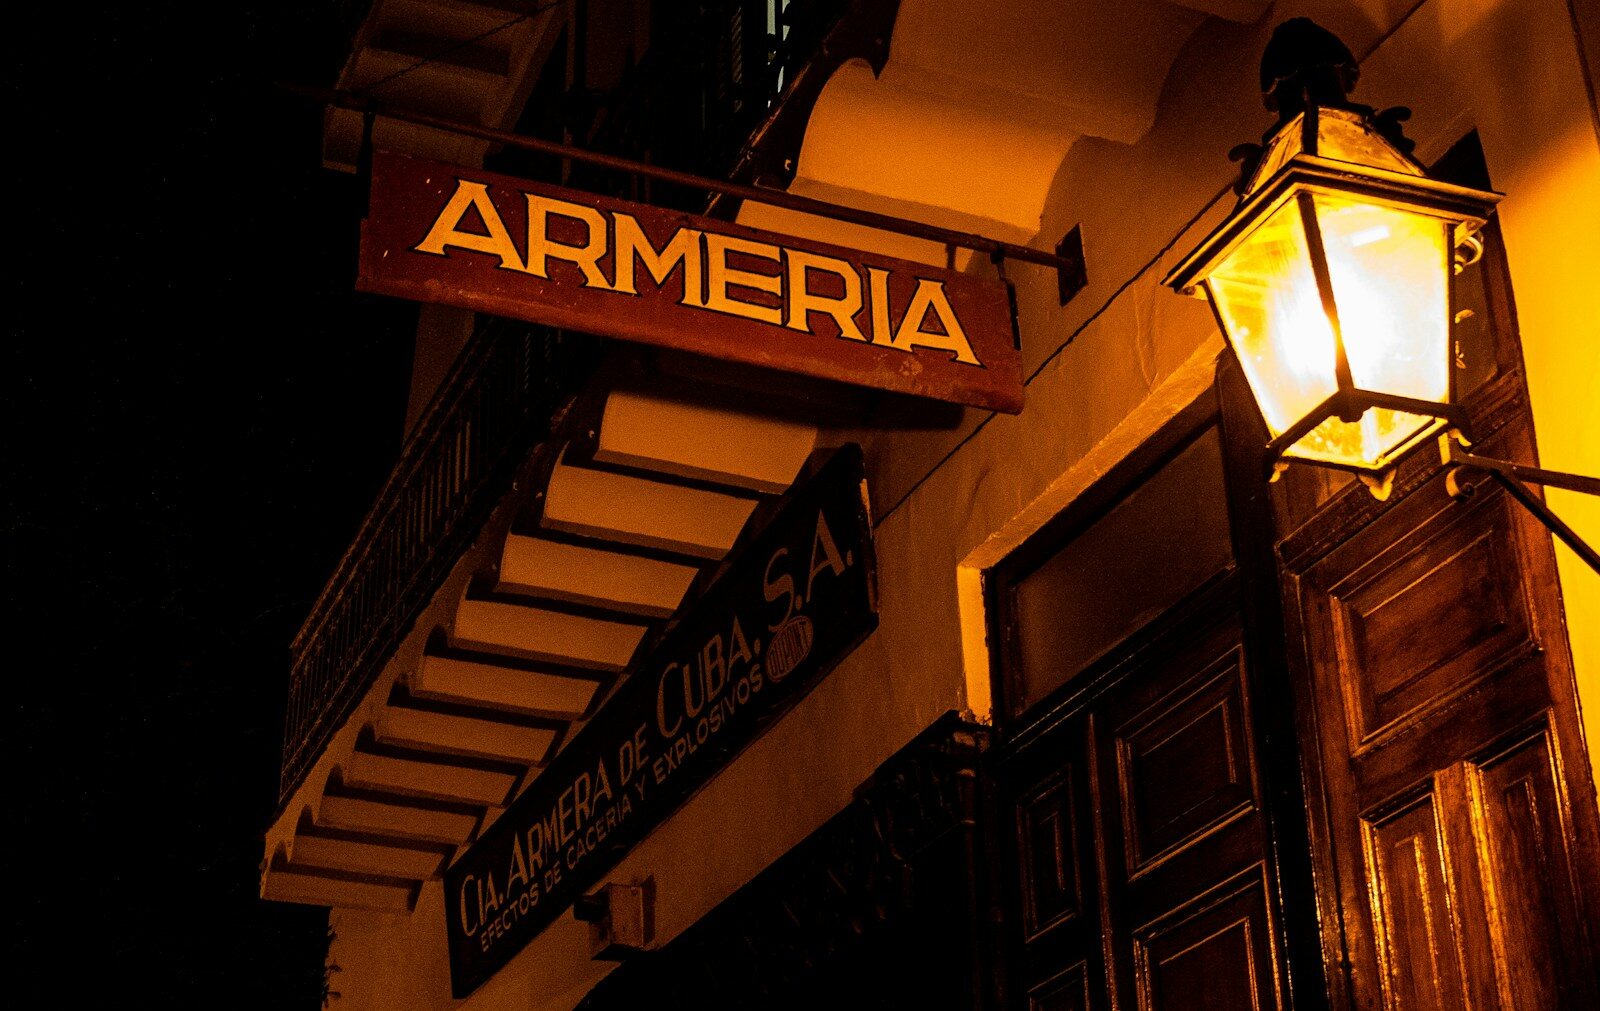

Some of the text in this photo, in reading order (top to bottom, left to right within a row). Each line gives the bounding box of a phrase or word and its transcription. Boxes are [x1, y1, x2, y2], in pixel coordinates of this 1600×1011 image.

[413, 178, 981, 367] ARMERIA
[460, 871, 503, 937] CIA.
[507, 756, 613, 900] ARMERA
[618, 721, 649, 787] DE
[763, 507, 854, 633] S.A.
[480, 662, 764, 952] EFECTOS DE CACERIA Y EXPLOSIVOS
